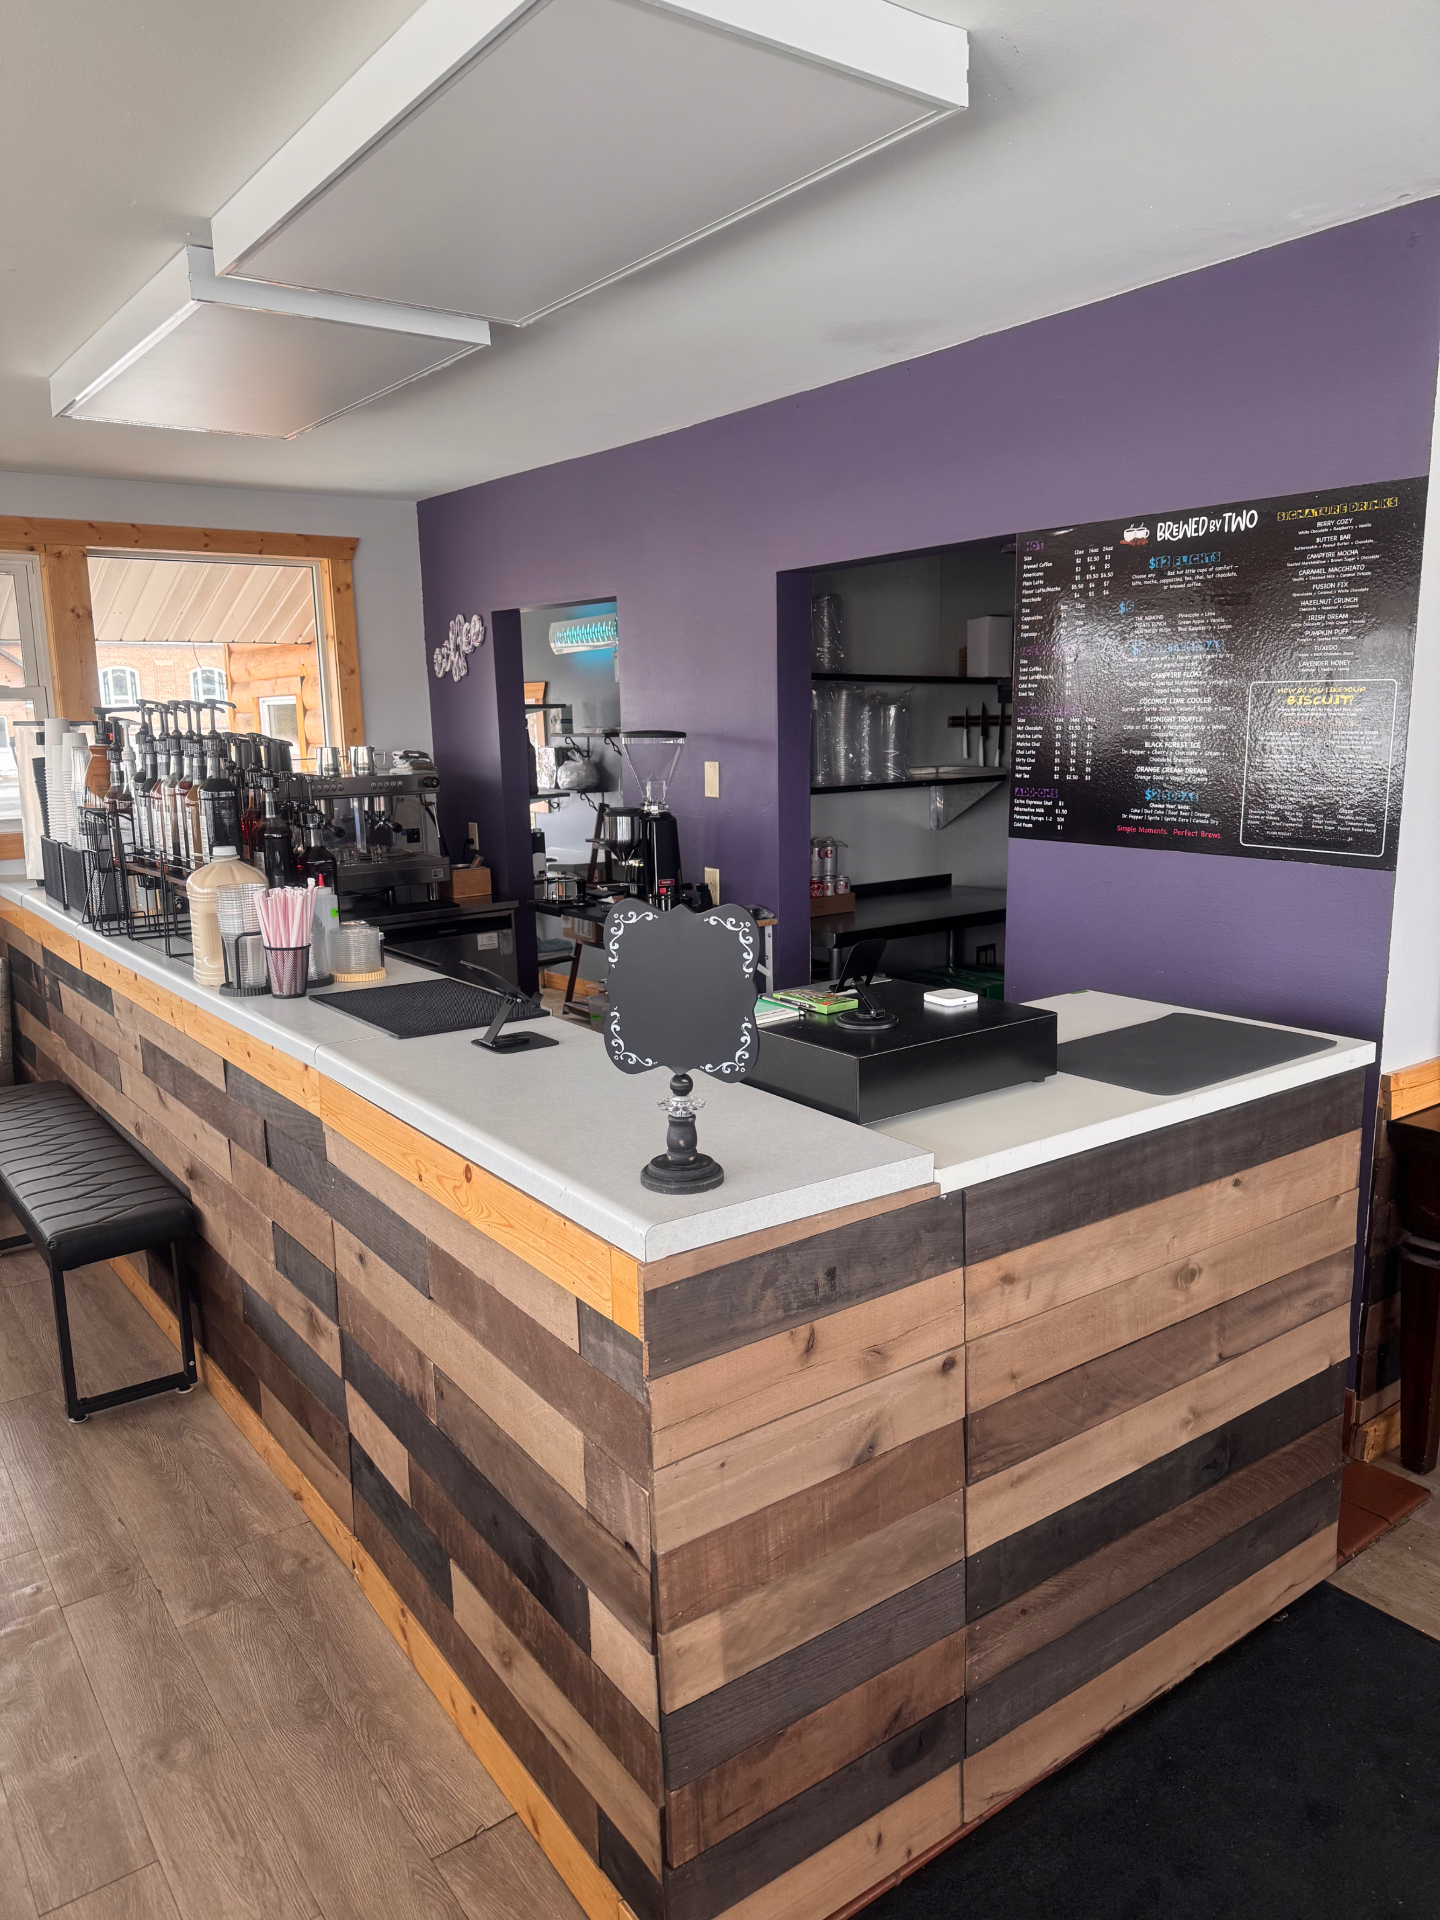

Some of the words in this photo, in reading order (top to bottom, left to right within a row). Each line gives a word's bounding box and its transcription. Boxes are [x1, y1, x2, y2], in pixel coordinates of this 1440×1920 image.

[1277, 503, 1348, 521] SIGNATURE
[1349, 497, 1398, 512] DRINKS
[1210, 519, 1222, 532] BY
[1223, 510, 1258, 533] TWO
[1149, 556, 1170, 570] $12
[1173, 552, 1221, 566] FLIGHTS
[1299, 568, 1326, 576] CARAMEL
[1328, 565, 1365, 573] MACCHIATO
[1287, 695, 1354, 706] BISCUIT?
[1014, 788, 1058, 798] ADD-ONS
[1117, 825, 1136, 833] Simple
[1138, 826, 1168, 835] Moments.
[1173, 829, 1198, 837] Perfect
[1201, 831, 1222, 839] Brews.
